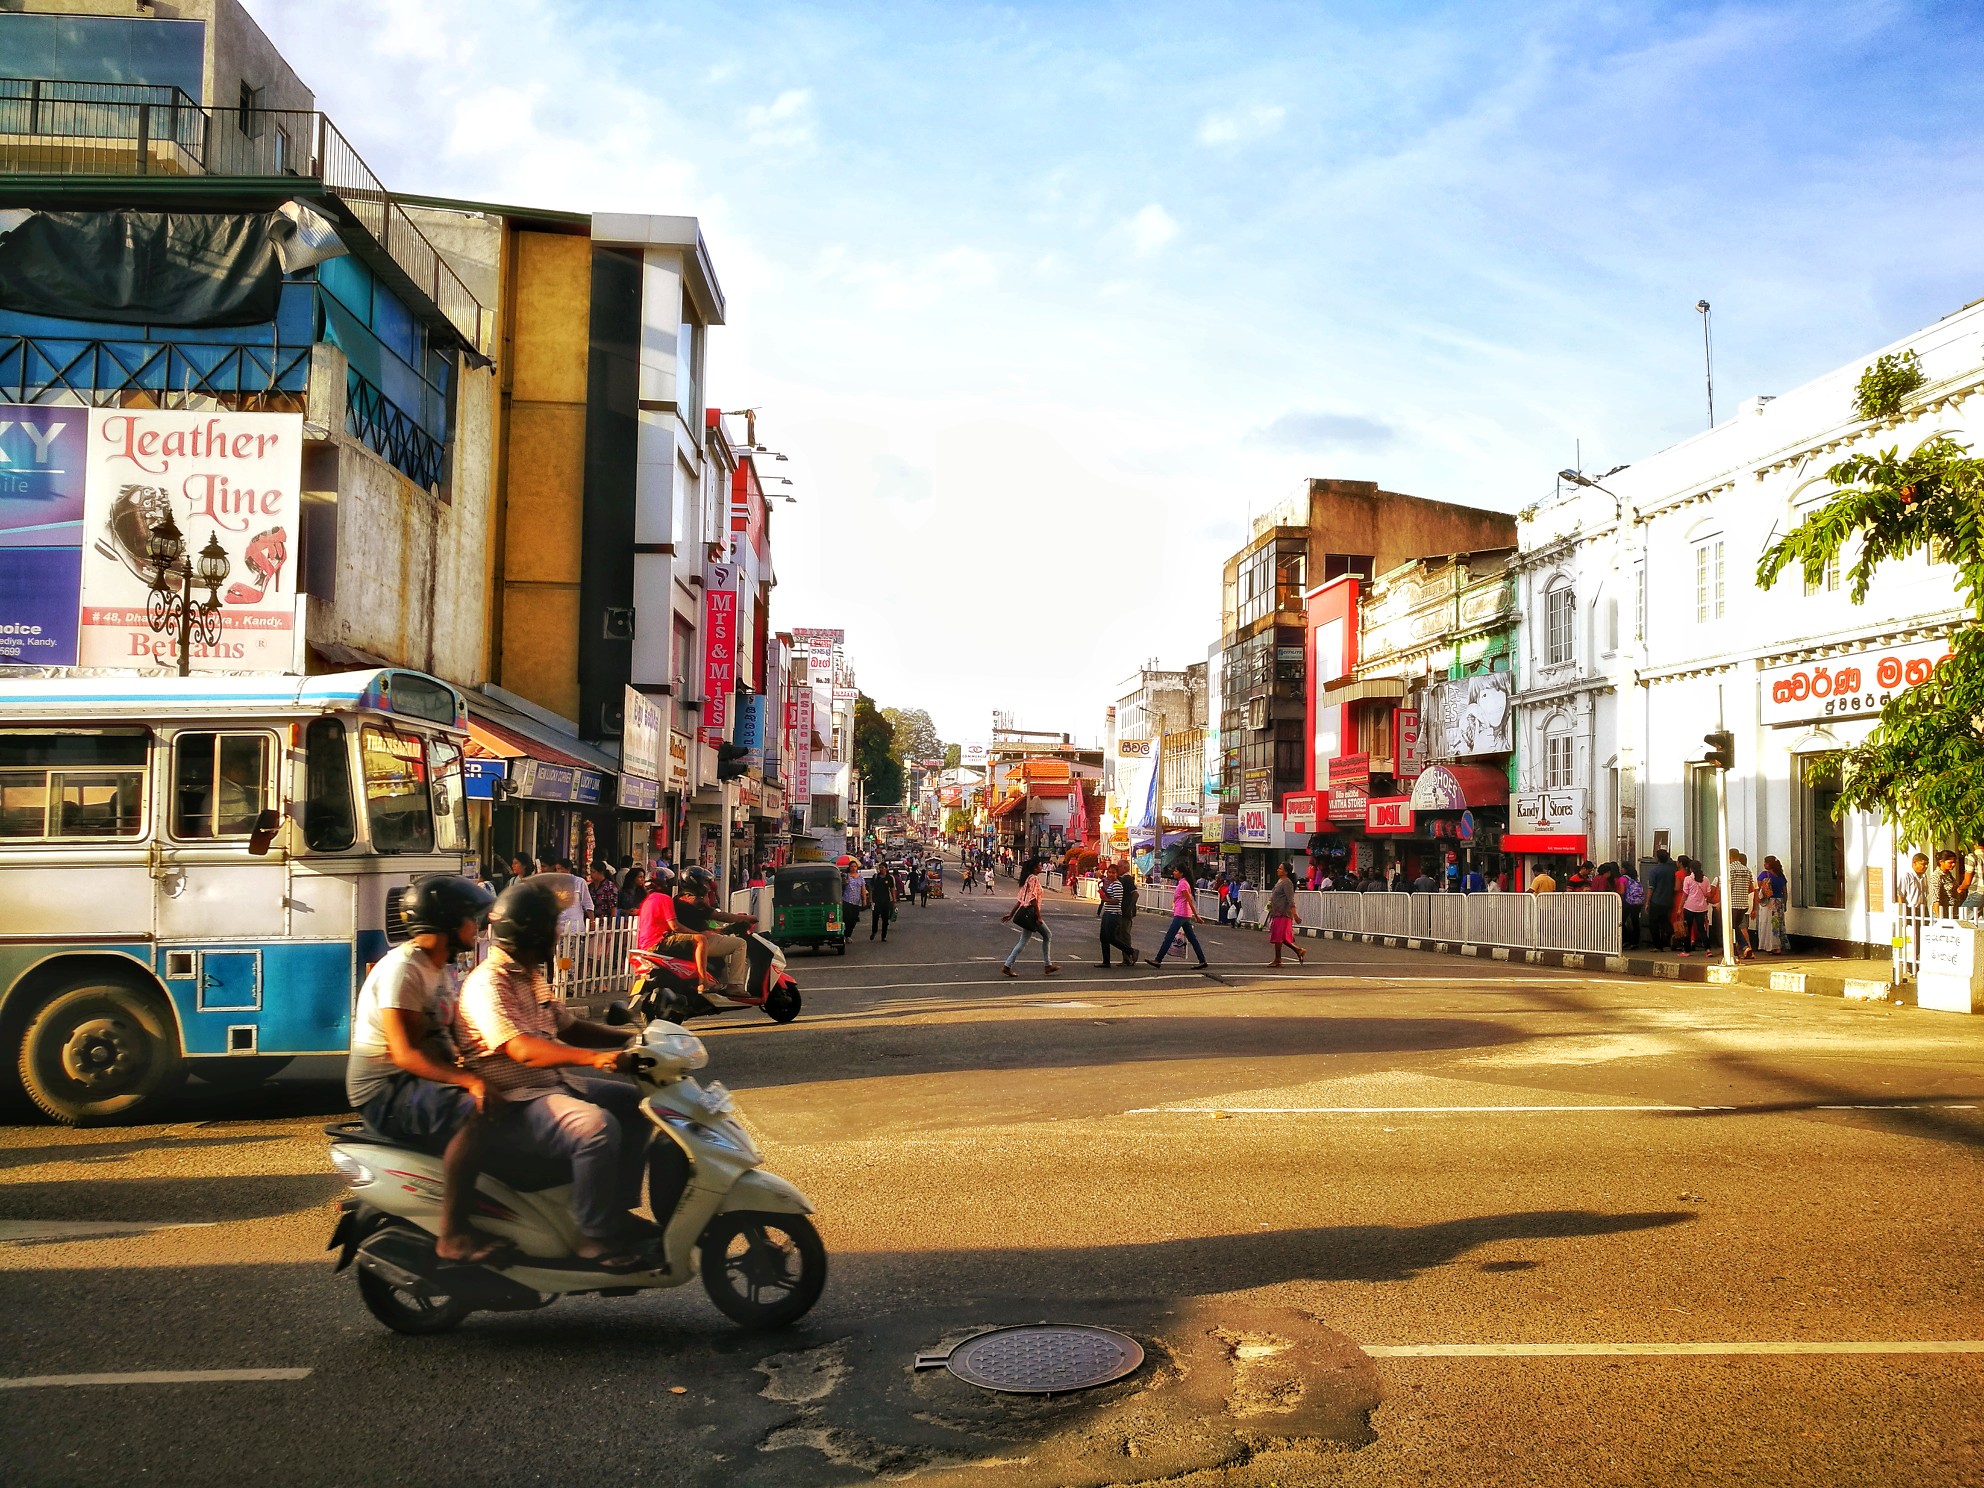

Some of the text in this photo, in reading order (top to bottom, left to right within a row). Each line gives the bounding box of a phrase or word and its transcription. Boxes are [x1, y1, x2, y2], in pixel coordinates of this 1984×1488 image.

[102, 415, 279, 474] Leather
[183, 473, 282, 531] Line
[243, 616, 282, 626] Kandy.
[27, 637, 58, 648] Kandy.
[127, 632, 245, 659] Betans
[709, 594, 732, 724] Mrs & Miss
[1404, 715, 1418, 759] DSI
[1433, 770, 1458, 798] SHOES
[1173, 806, 1198, 814] Bata
[1347, 797, 1367, 808] STORES
[1517, 803, 1539, 819] Kandy
[1550, 801, 1573, 816] Stores
[1246, 811, 1267, 829] ROYAL
[1376, 804, 1402, 825] DSI
